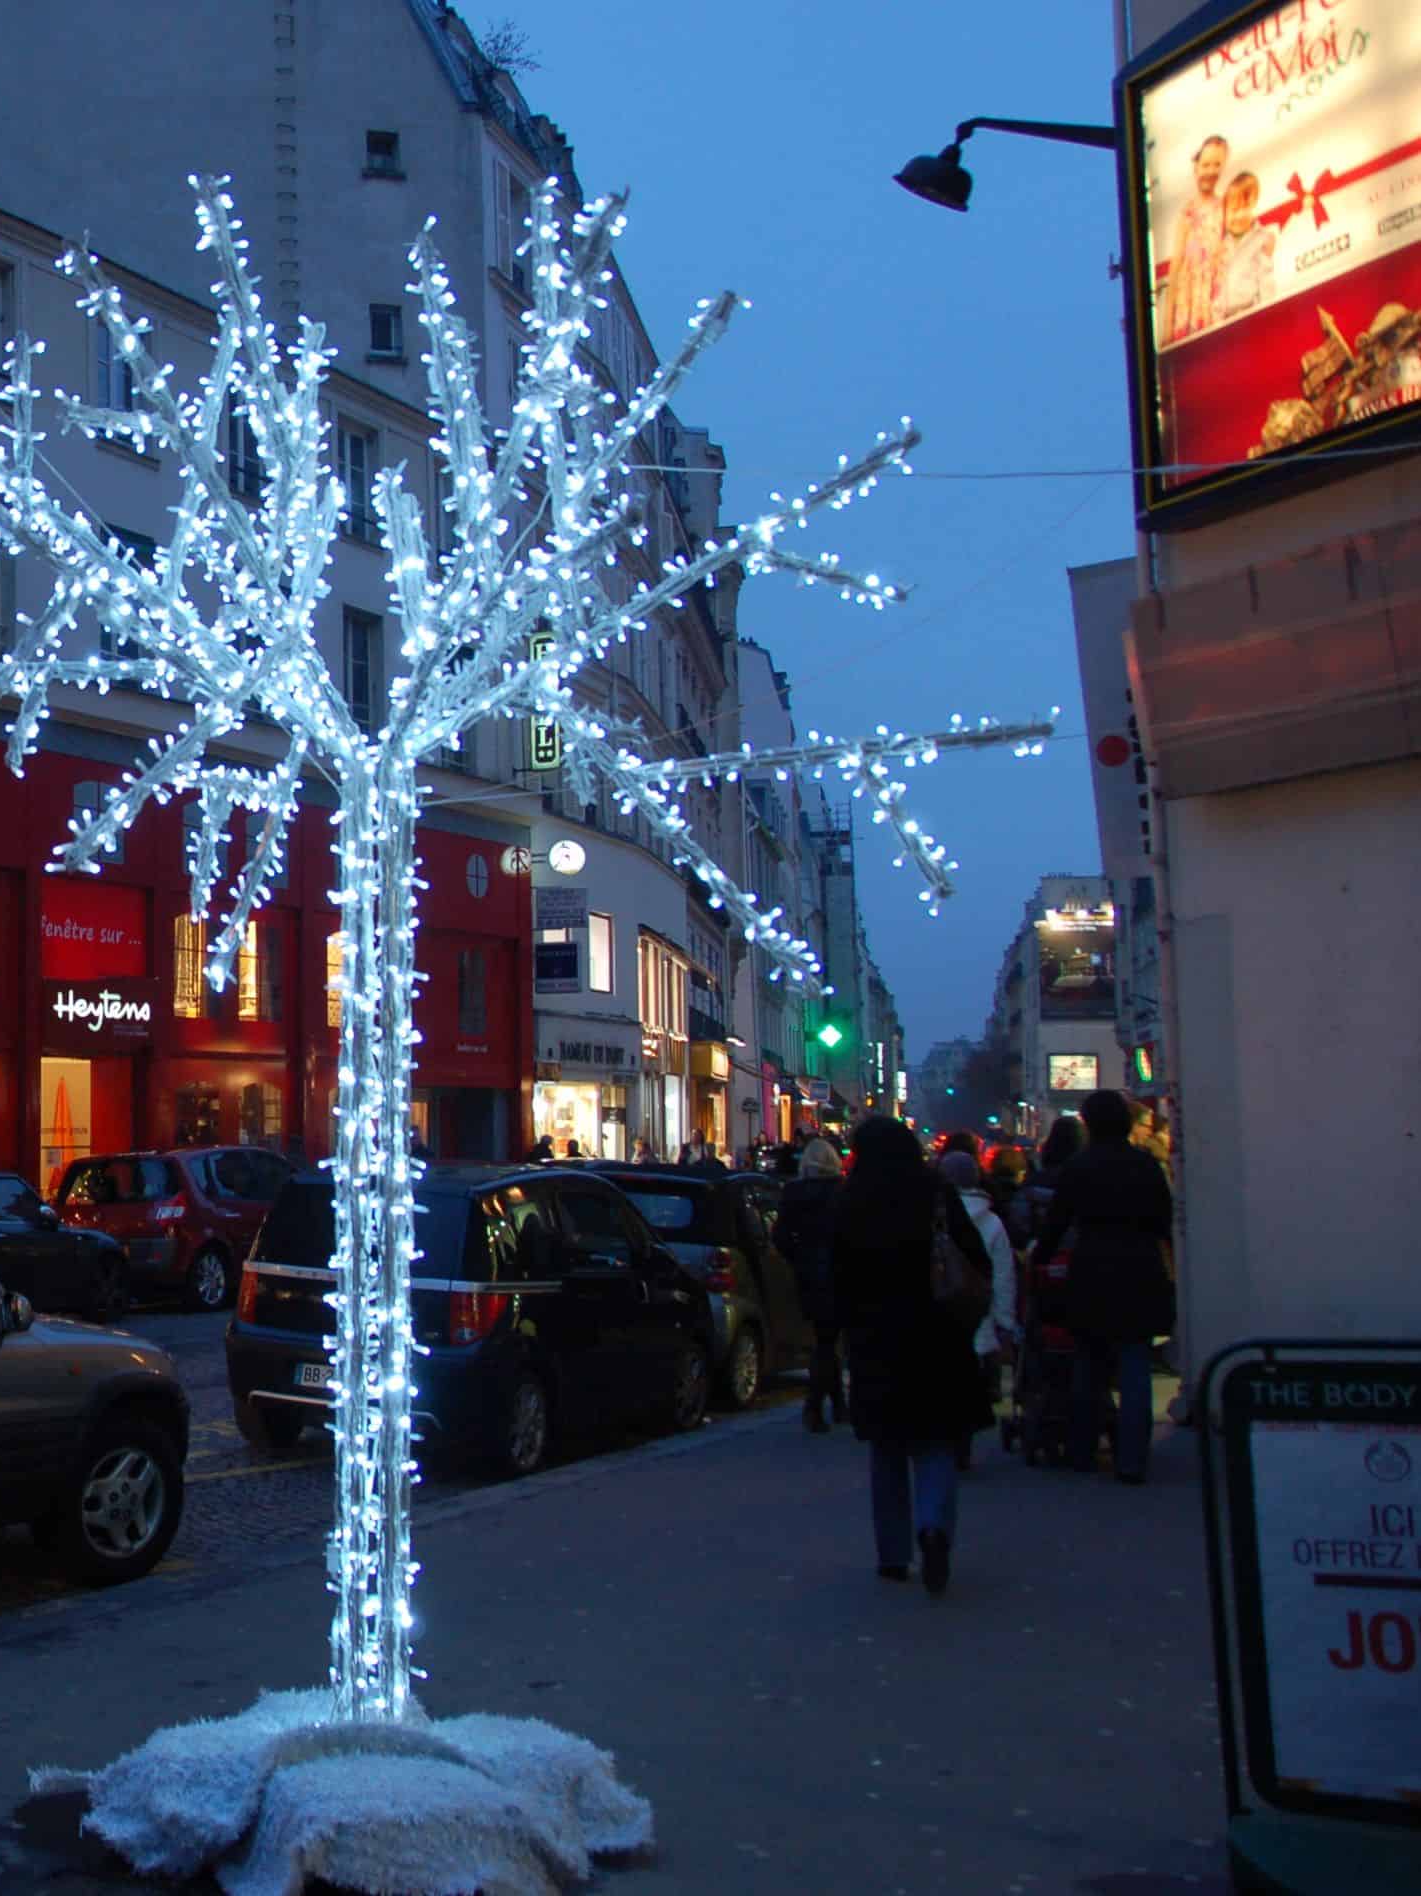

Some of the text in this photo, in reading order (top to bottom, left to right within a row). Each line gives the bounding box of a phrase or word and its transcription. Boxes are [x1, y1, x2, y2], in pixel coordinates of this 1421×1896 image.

[100, 927, 125, 944] sur
[52, 988, 152, 1032] Heytens
[1249, 1381, 1419, 1409] THE BODY
[1369, 1503, 1415, 1537] ICI
[1292, 1538, 1404, 1569] OFFREZ
[1326, 1608, 1421, 1673] JO
